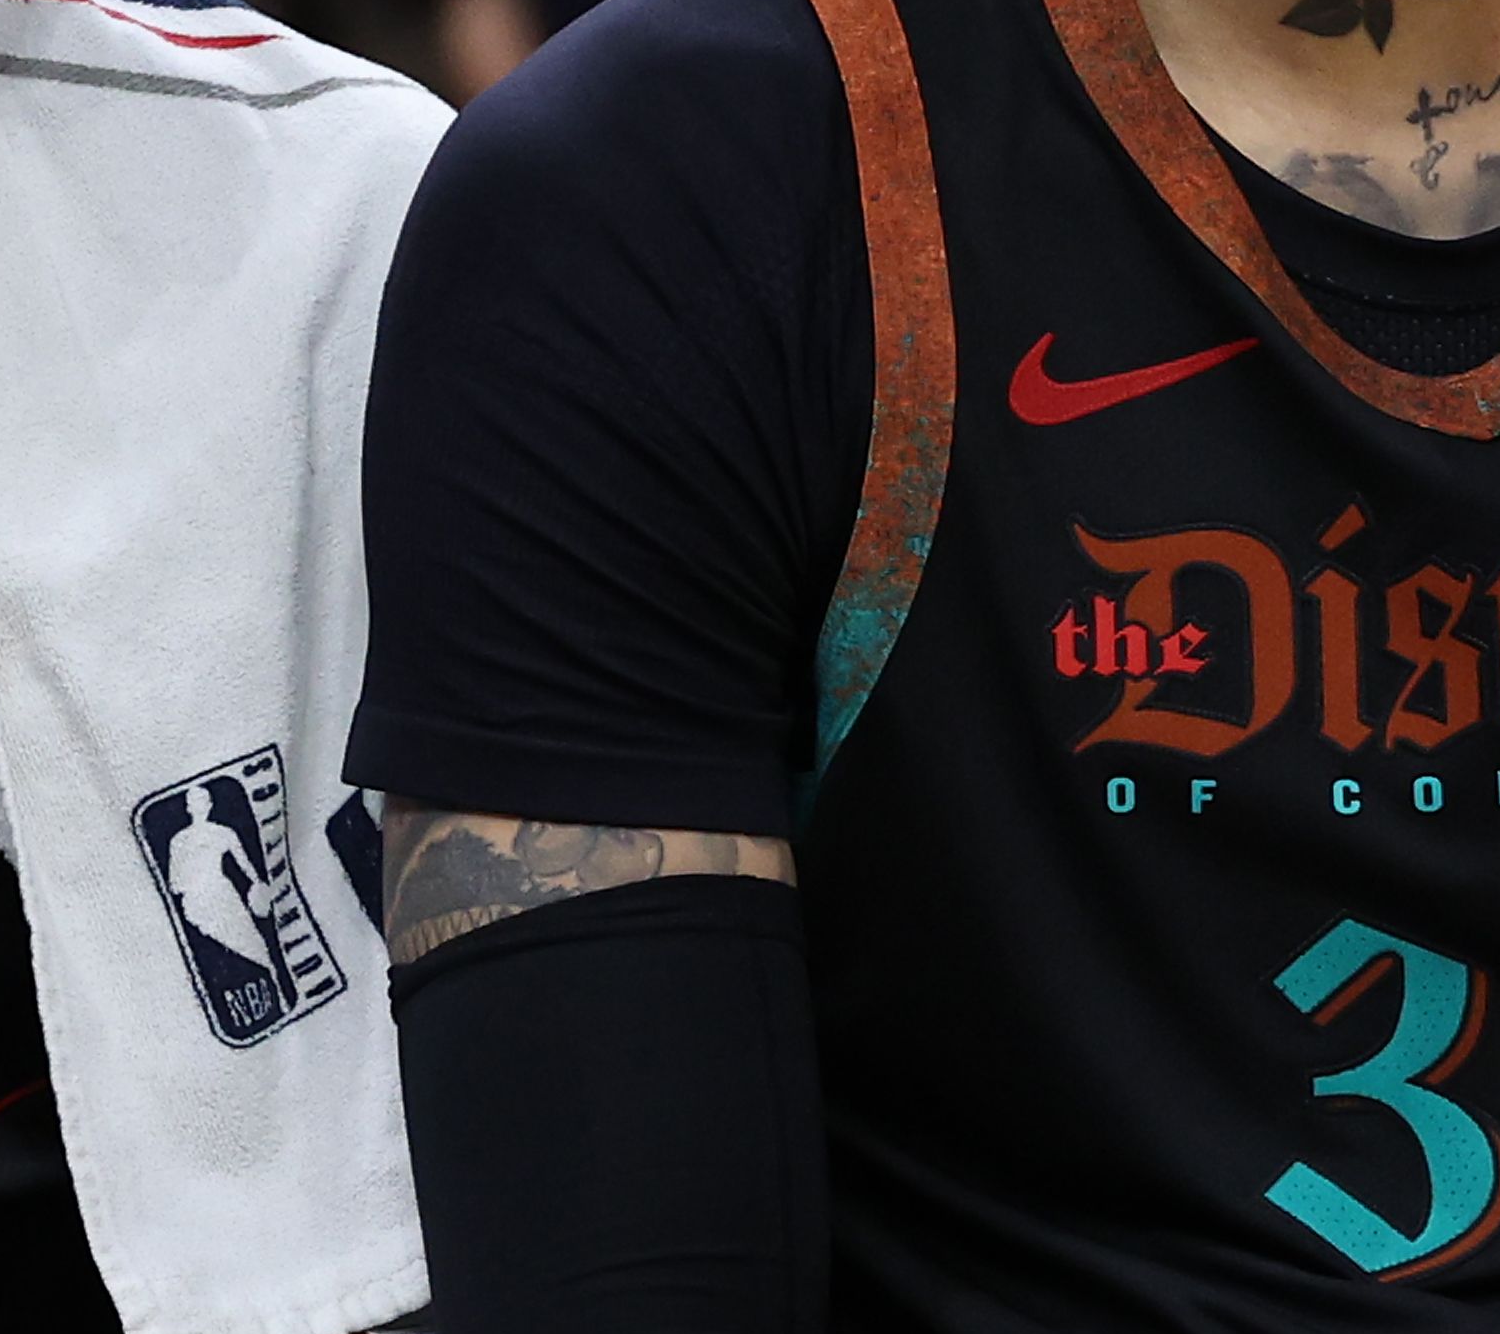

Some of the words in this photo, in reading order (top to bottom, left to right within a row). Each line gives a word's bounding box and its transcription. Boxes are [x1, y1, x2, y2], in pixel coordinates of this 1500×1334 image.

[1049, 595, 1211, 676] the
[1106, 777, 1217, 814] OF
[243, 757, 336, 999] AUTHENTICS
[224, 978, 274, 1027] NBA
